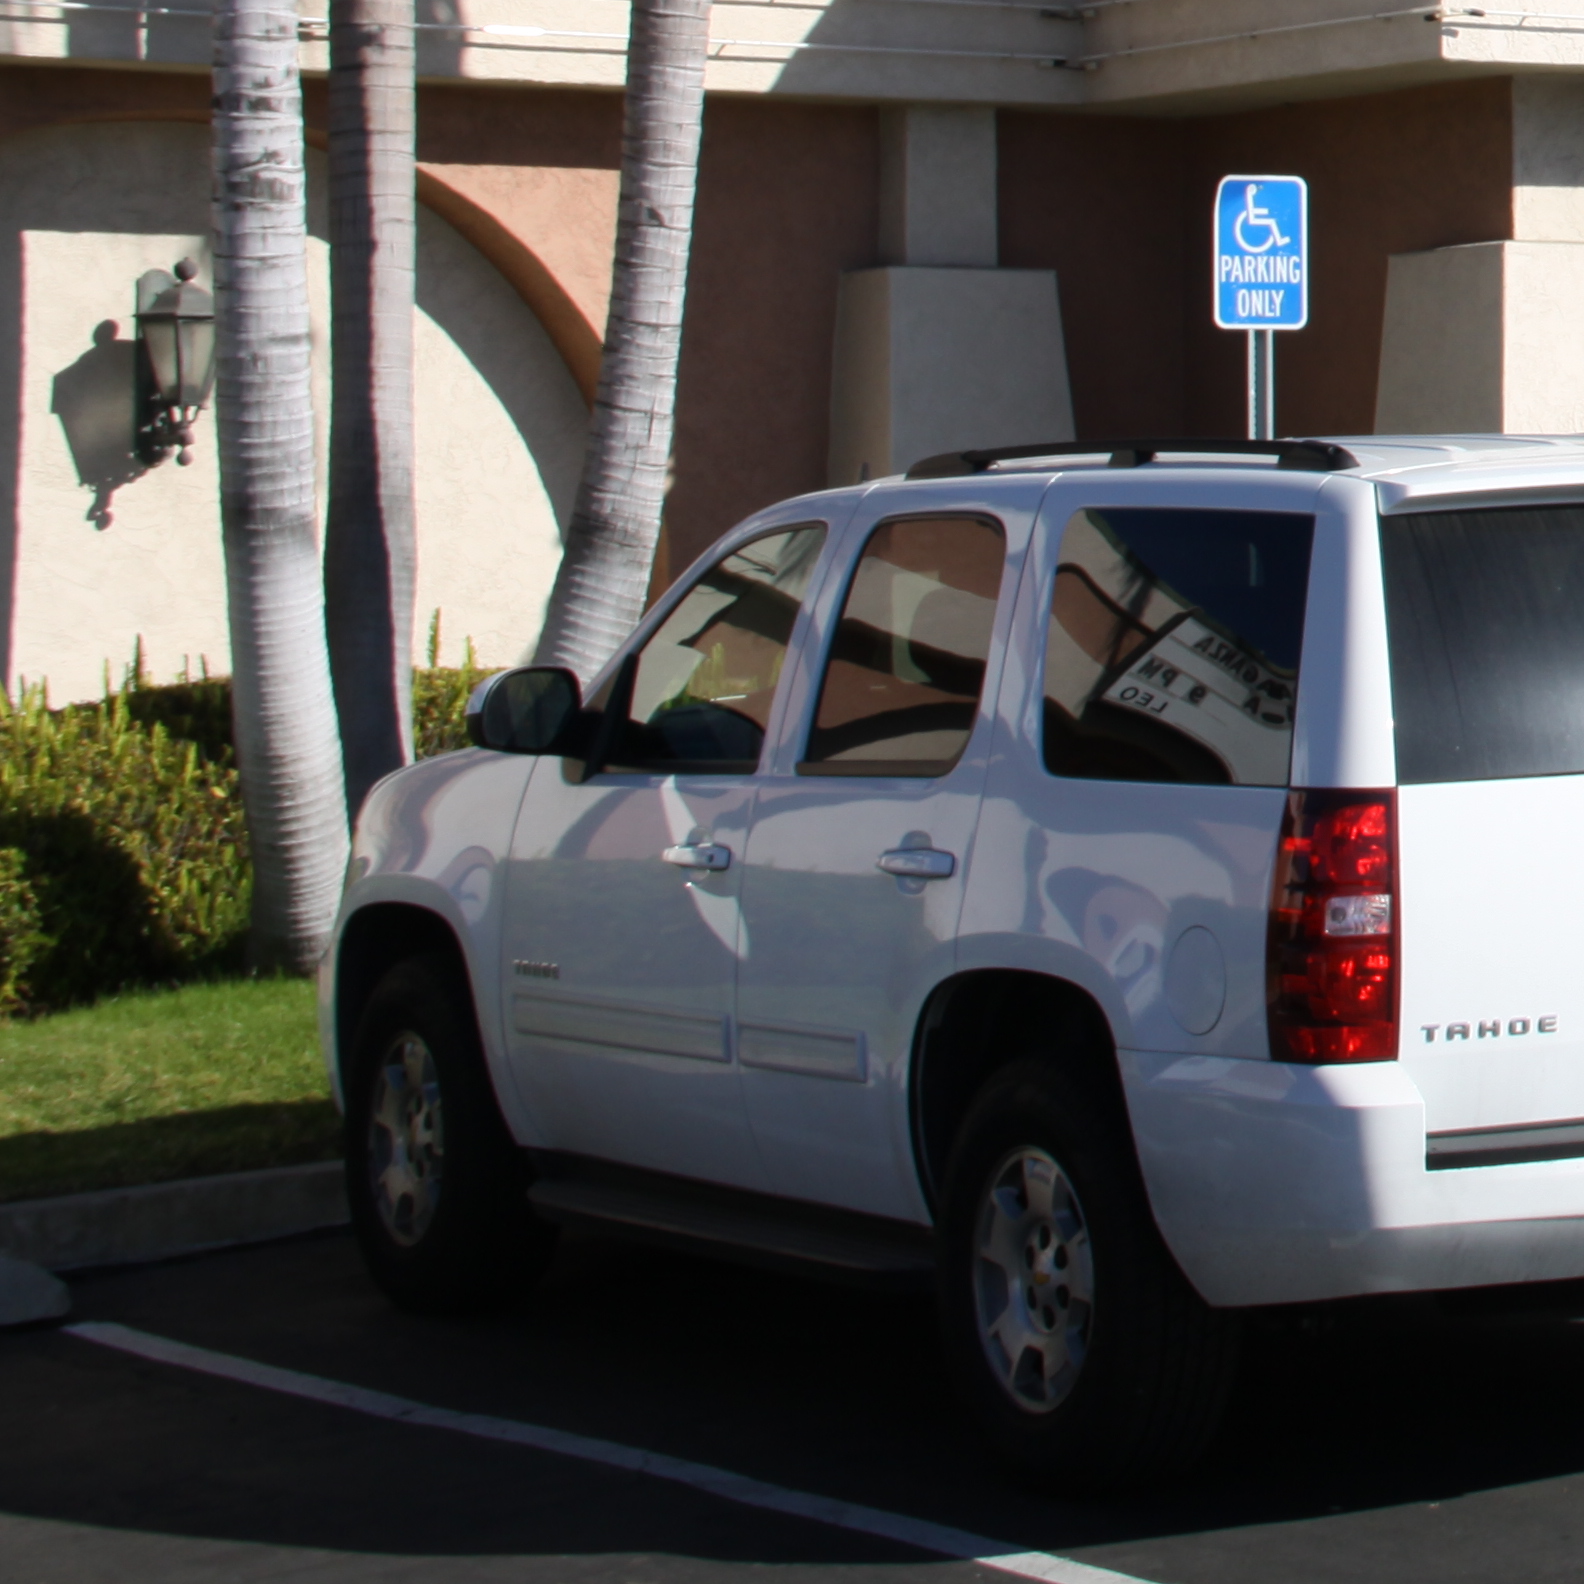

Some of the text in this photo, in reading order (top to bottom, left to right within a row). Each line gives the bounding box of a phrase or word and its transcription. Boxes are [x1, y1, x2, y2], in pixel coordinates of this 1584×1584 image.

[1220, 255, 1300, 284] PARKING
[1237, 288, 1285, 317] ONLY
[1420, 1014, 1558, 1043] TAHOE
